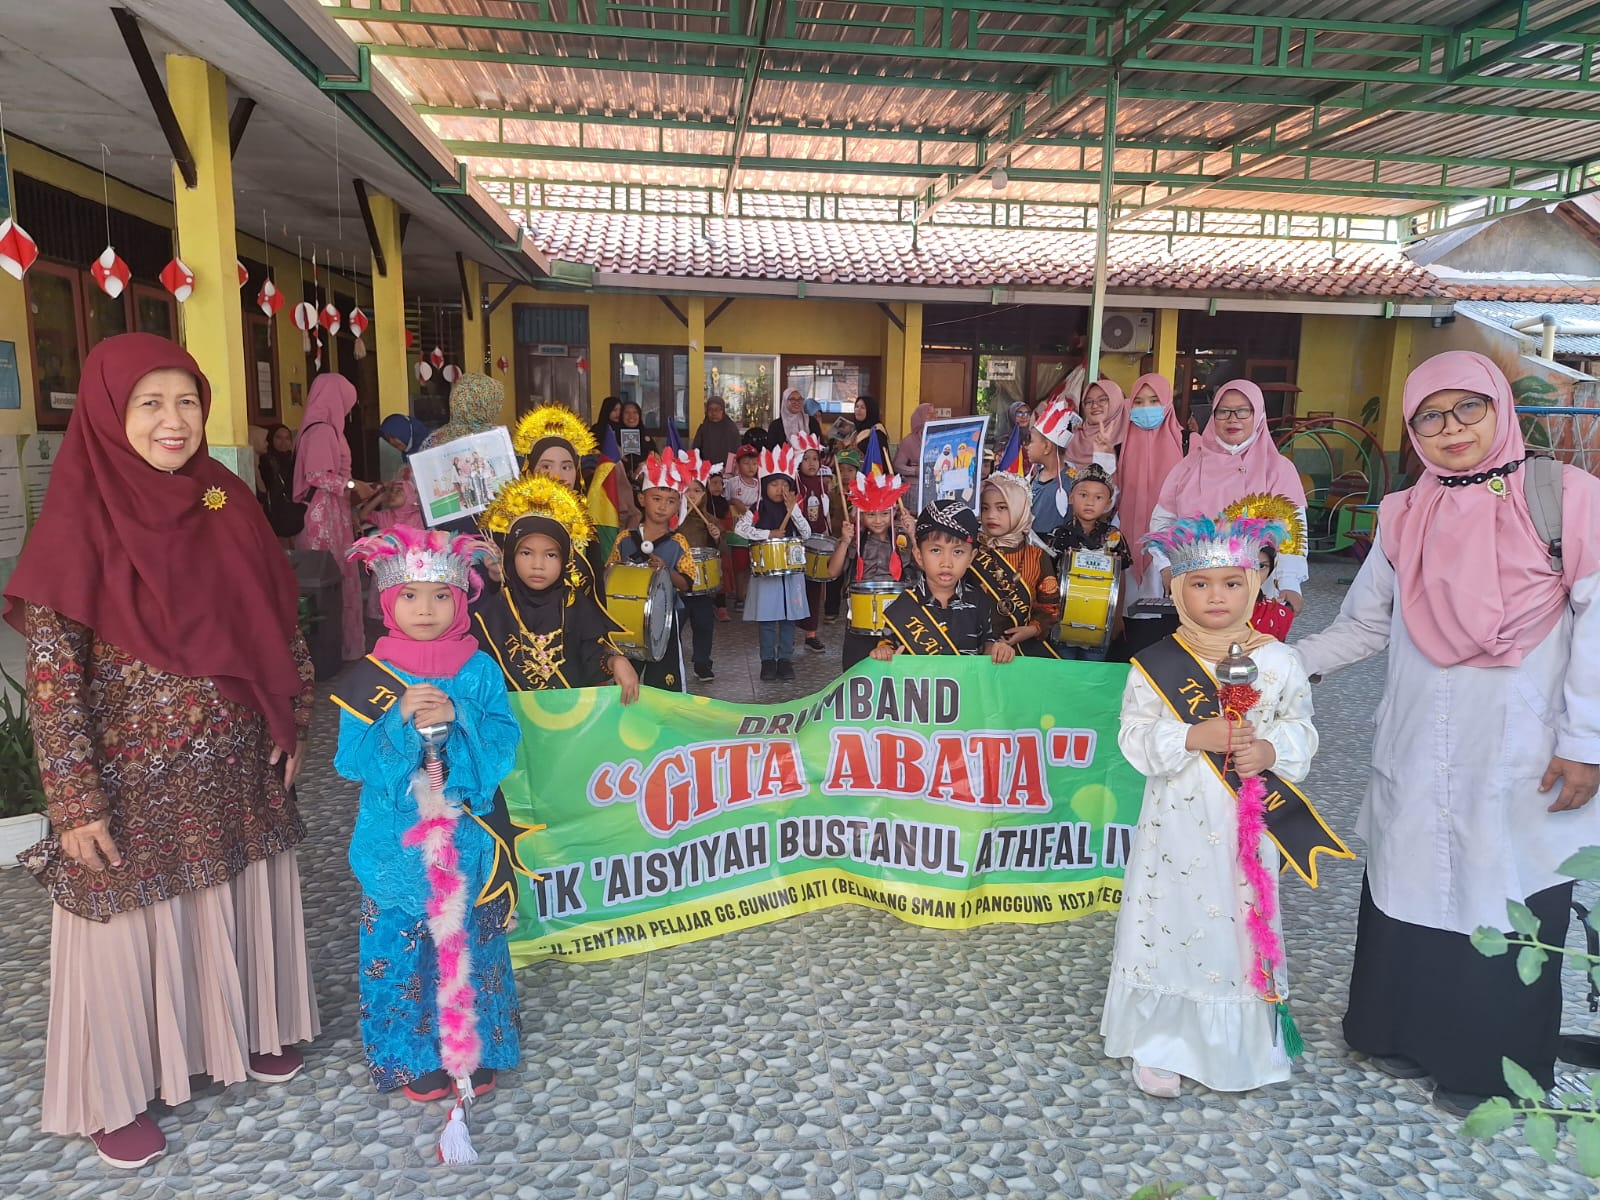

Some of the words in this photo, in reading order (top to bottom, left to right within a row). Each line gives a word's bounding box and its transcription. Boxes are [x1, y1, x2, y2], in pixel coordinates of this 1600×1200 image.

[904, 616, 929, 644] TK
[737, 675, 959, 735] DRUMBAND
[1178, 677, 1211, 716] TK
[533, 866, 582, 917] TK
[780, 818, 965, 874] BUSTANUL
[975, 825, 1093, 874] ATHFAL
[651, 910, 714, 938] PELAJAR
[715, 886, 799, 921] GG.GUNUNG
[800, 880, 828, 902] JATI
[832, 880, 907, 913] (BELAKANG
[911, 896, 956, 919] SMAN
[960, 900, 972, 919] 1)
[975, 895, 1053, 915] PANGGUNG
[1058, 890, 1095, 911] KOTA
